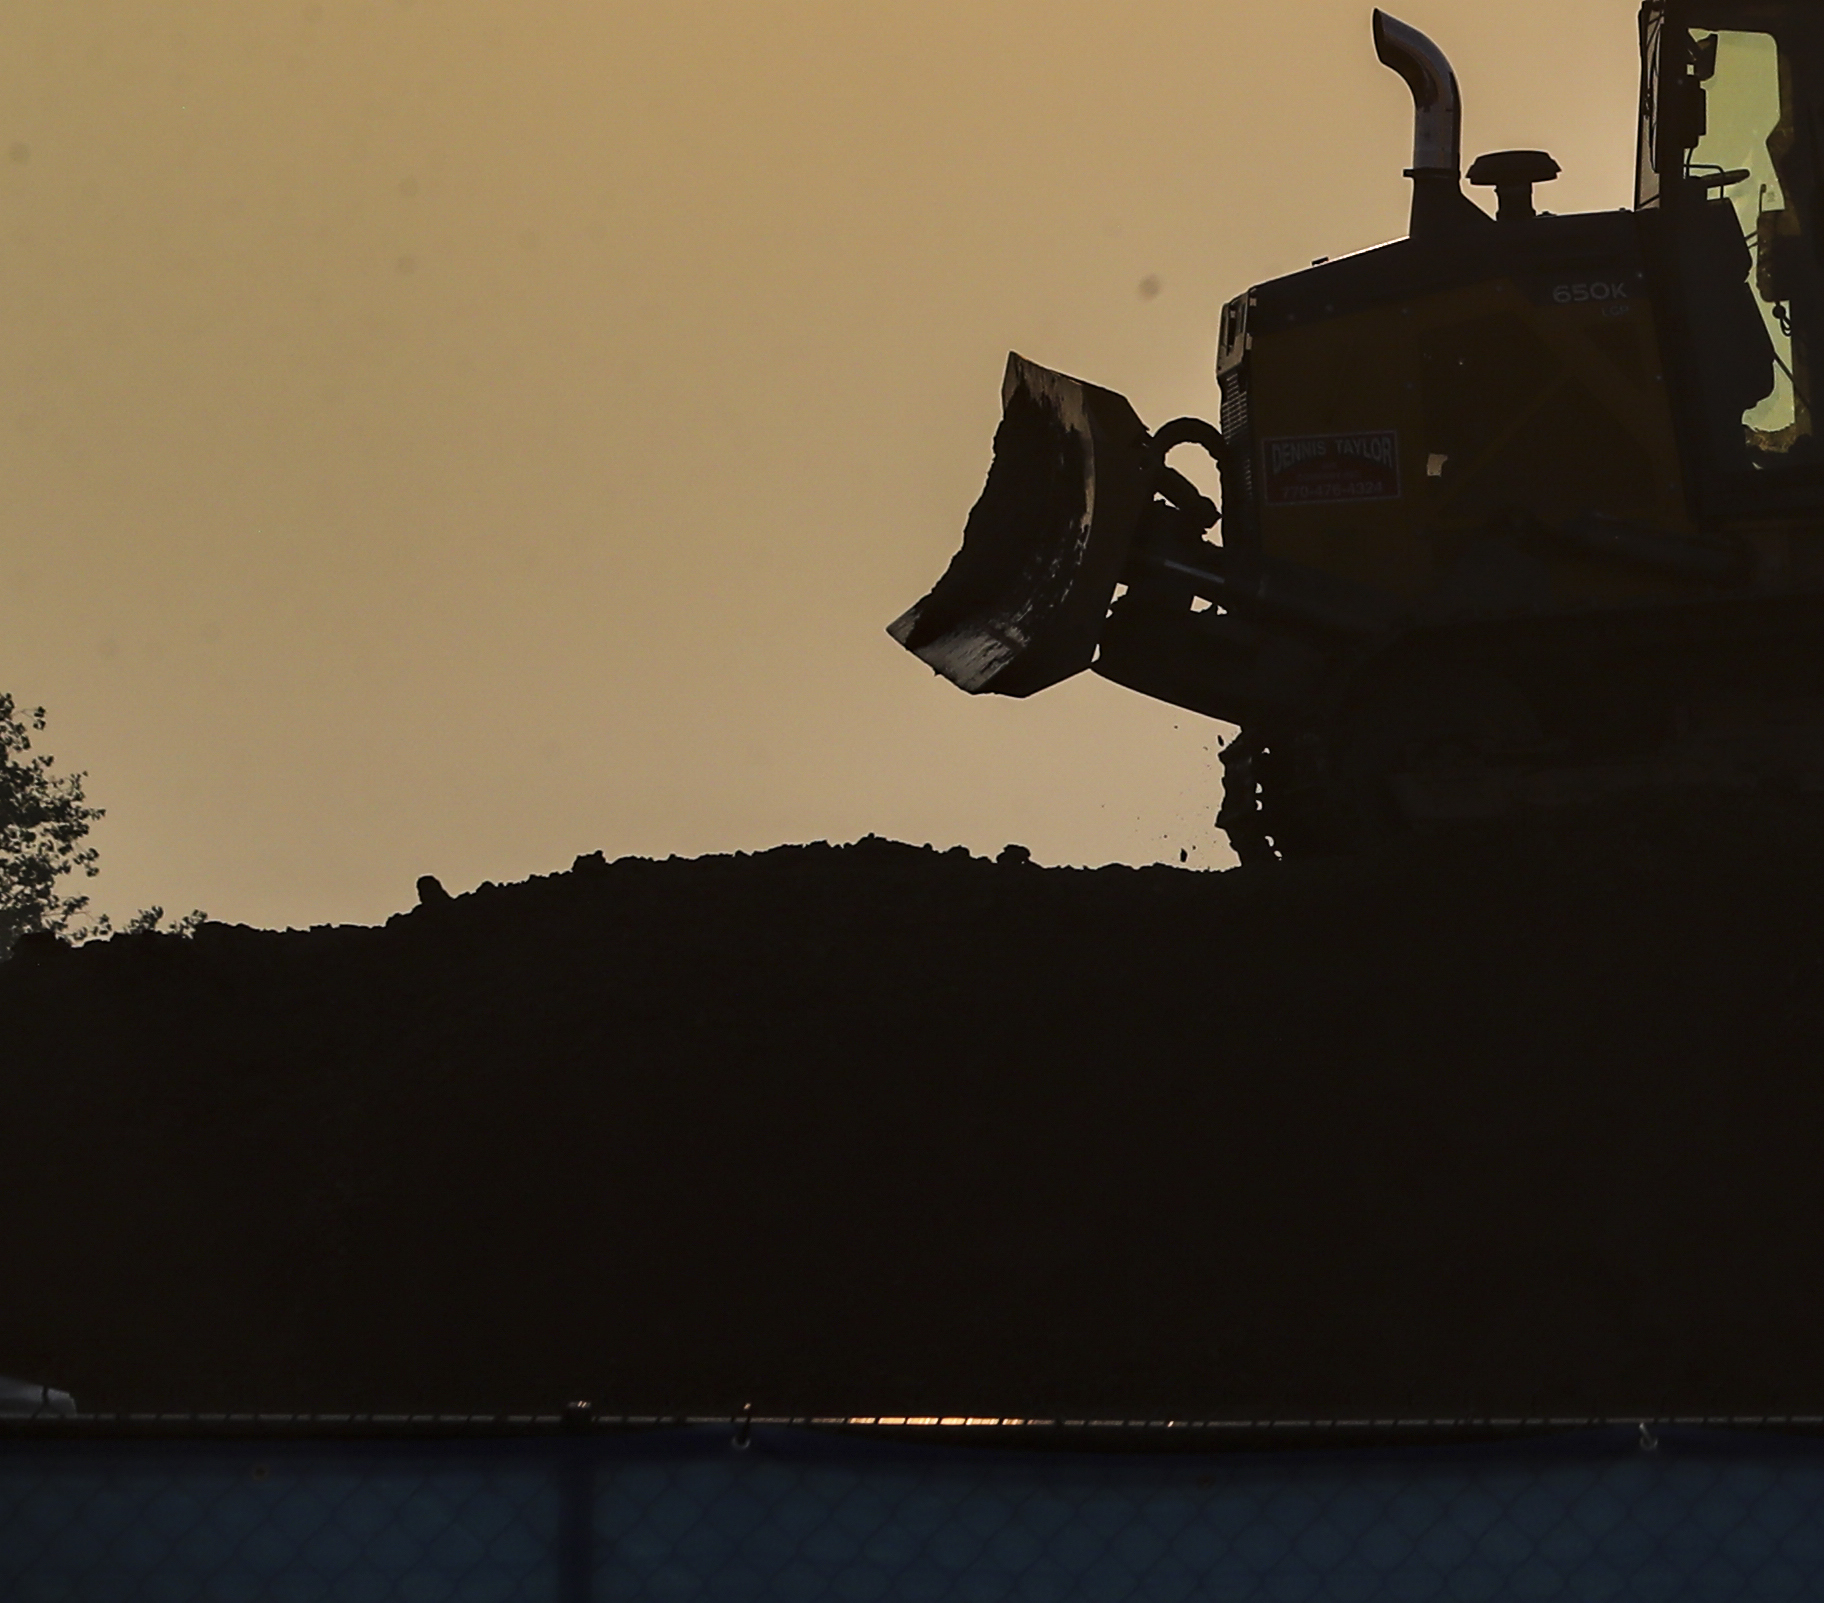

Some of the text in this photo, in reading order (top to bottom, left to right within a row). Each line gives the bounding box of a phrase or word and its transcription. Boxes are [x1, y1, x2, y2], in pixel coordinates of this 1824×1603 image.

[1552, 282, 1628, 303] 650K
[1271, 437, 1393, 475] DENNIS TAYLOR
[1281, 481, 1383, 499] 770-476-4324
